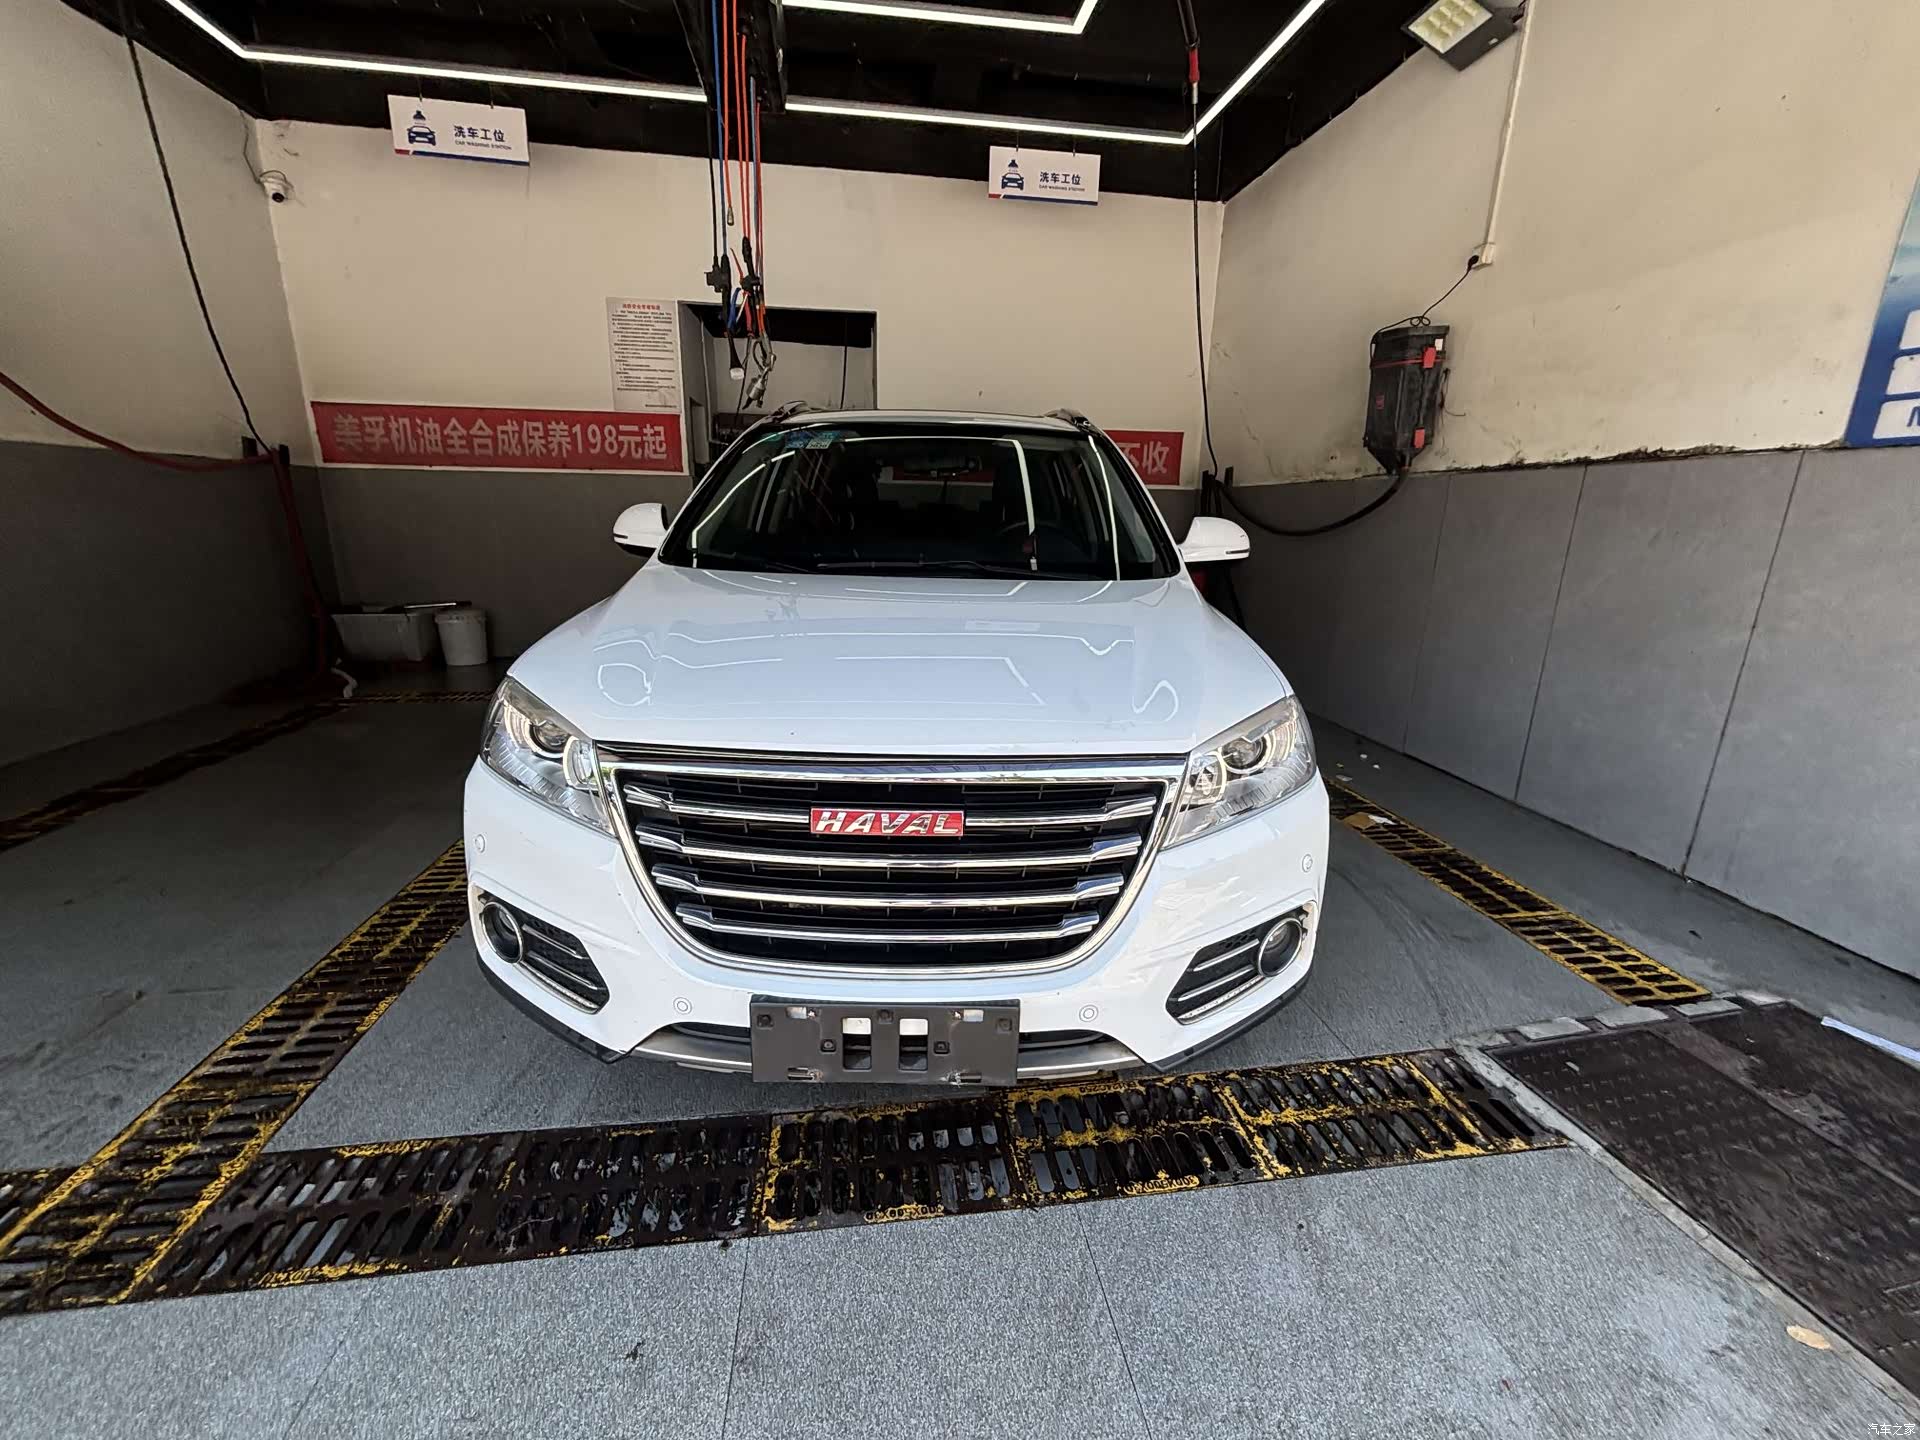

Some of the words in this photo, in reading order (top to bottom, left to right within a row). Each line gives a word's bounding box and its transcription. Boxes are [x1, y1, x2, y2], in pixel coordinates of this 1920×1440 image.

[453, 125, 505, 142] 洗车工位
[1039, 171, 1081, 185] 洗车工位
[333, 412, 668, 460] 美孚机油全合成保养198元起
[815, 811, 959, 834] HAVAL
